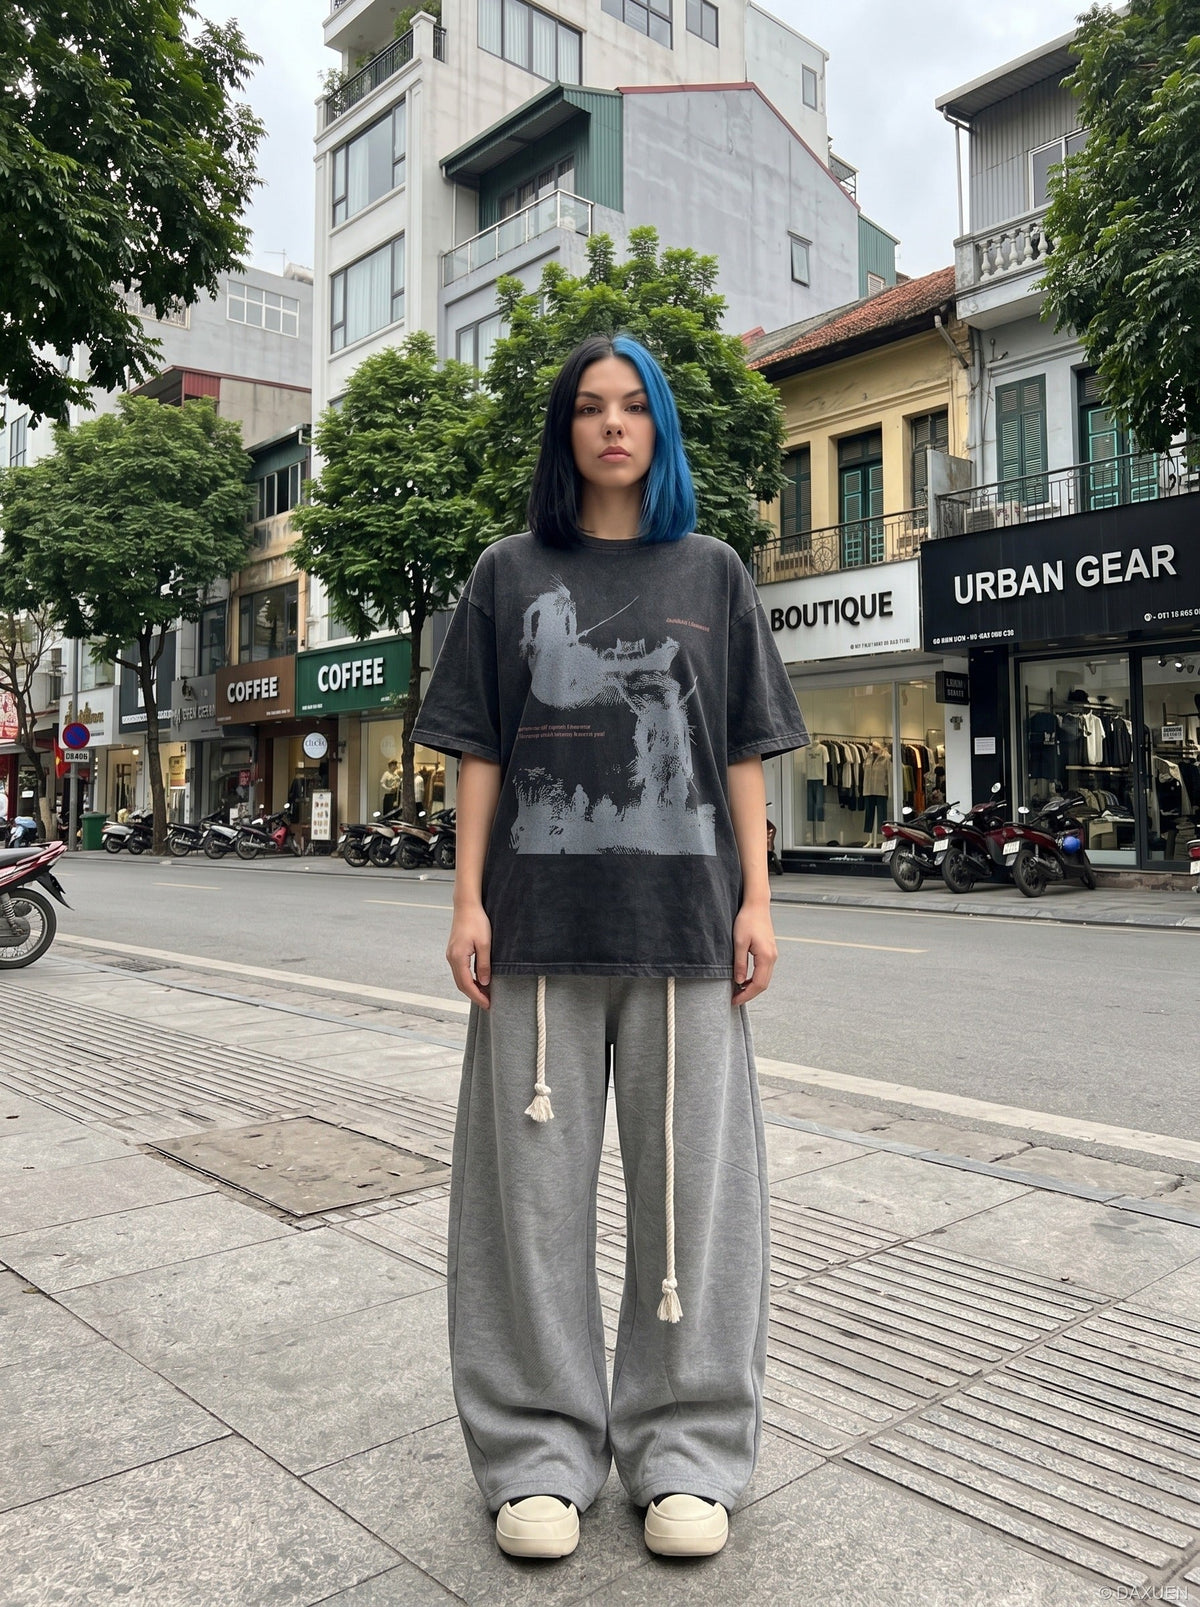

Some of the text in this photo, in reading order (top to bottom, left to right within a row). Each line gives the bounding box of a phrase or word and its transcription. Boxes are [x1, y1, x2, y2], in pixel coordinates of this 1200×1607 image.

[954, 544, 1177, 605] URBAN GEAR
[770, 590, 893, 632] BOUTIQUE
[227, 675, 278, 703] COFFEE
[317, 656, 384, 692] COFFEE
